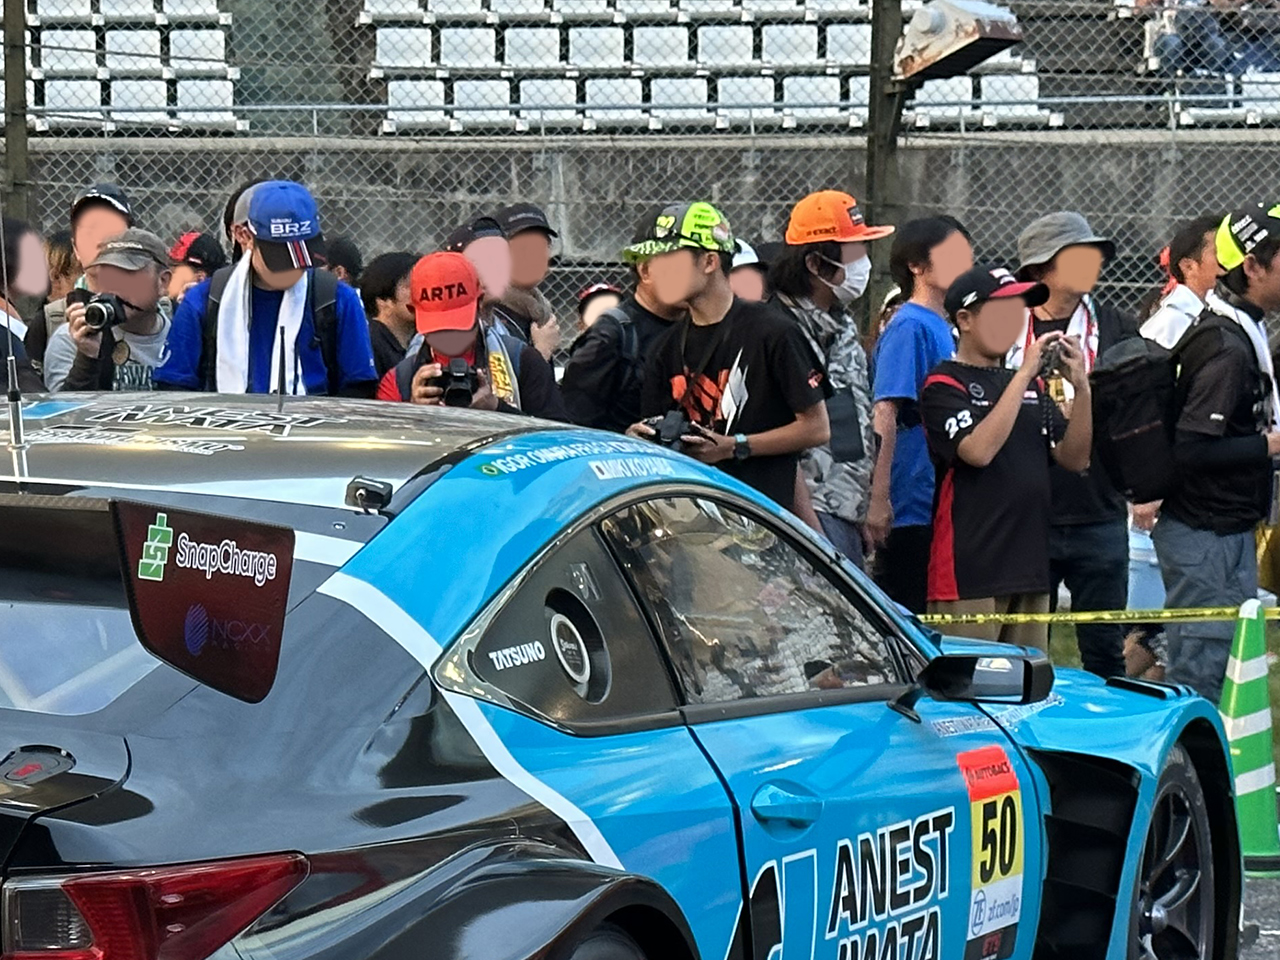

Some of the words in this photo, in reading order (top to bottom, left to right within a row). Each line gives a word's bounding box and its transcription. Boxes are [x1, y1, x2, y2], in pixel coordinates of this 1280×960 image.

[271, 221, 311, 234] BRZ
[420, 282, 468, 302] ARTA
[945, 409, 973, 440] 23
[496, 453, 538, 474] IGOR
[176, 532, 277, 586] SnapCharge
[489, 640, 546, 671] TATSUNO
[979, 794, 1017, 884] 50
[824, 805, 956, 941] ANEST
